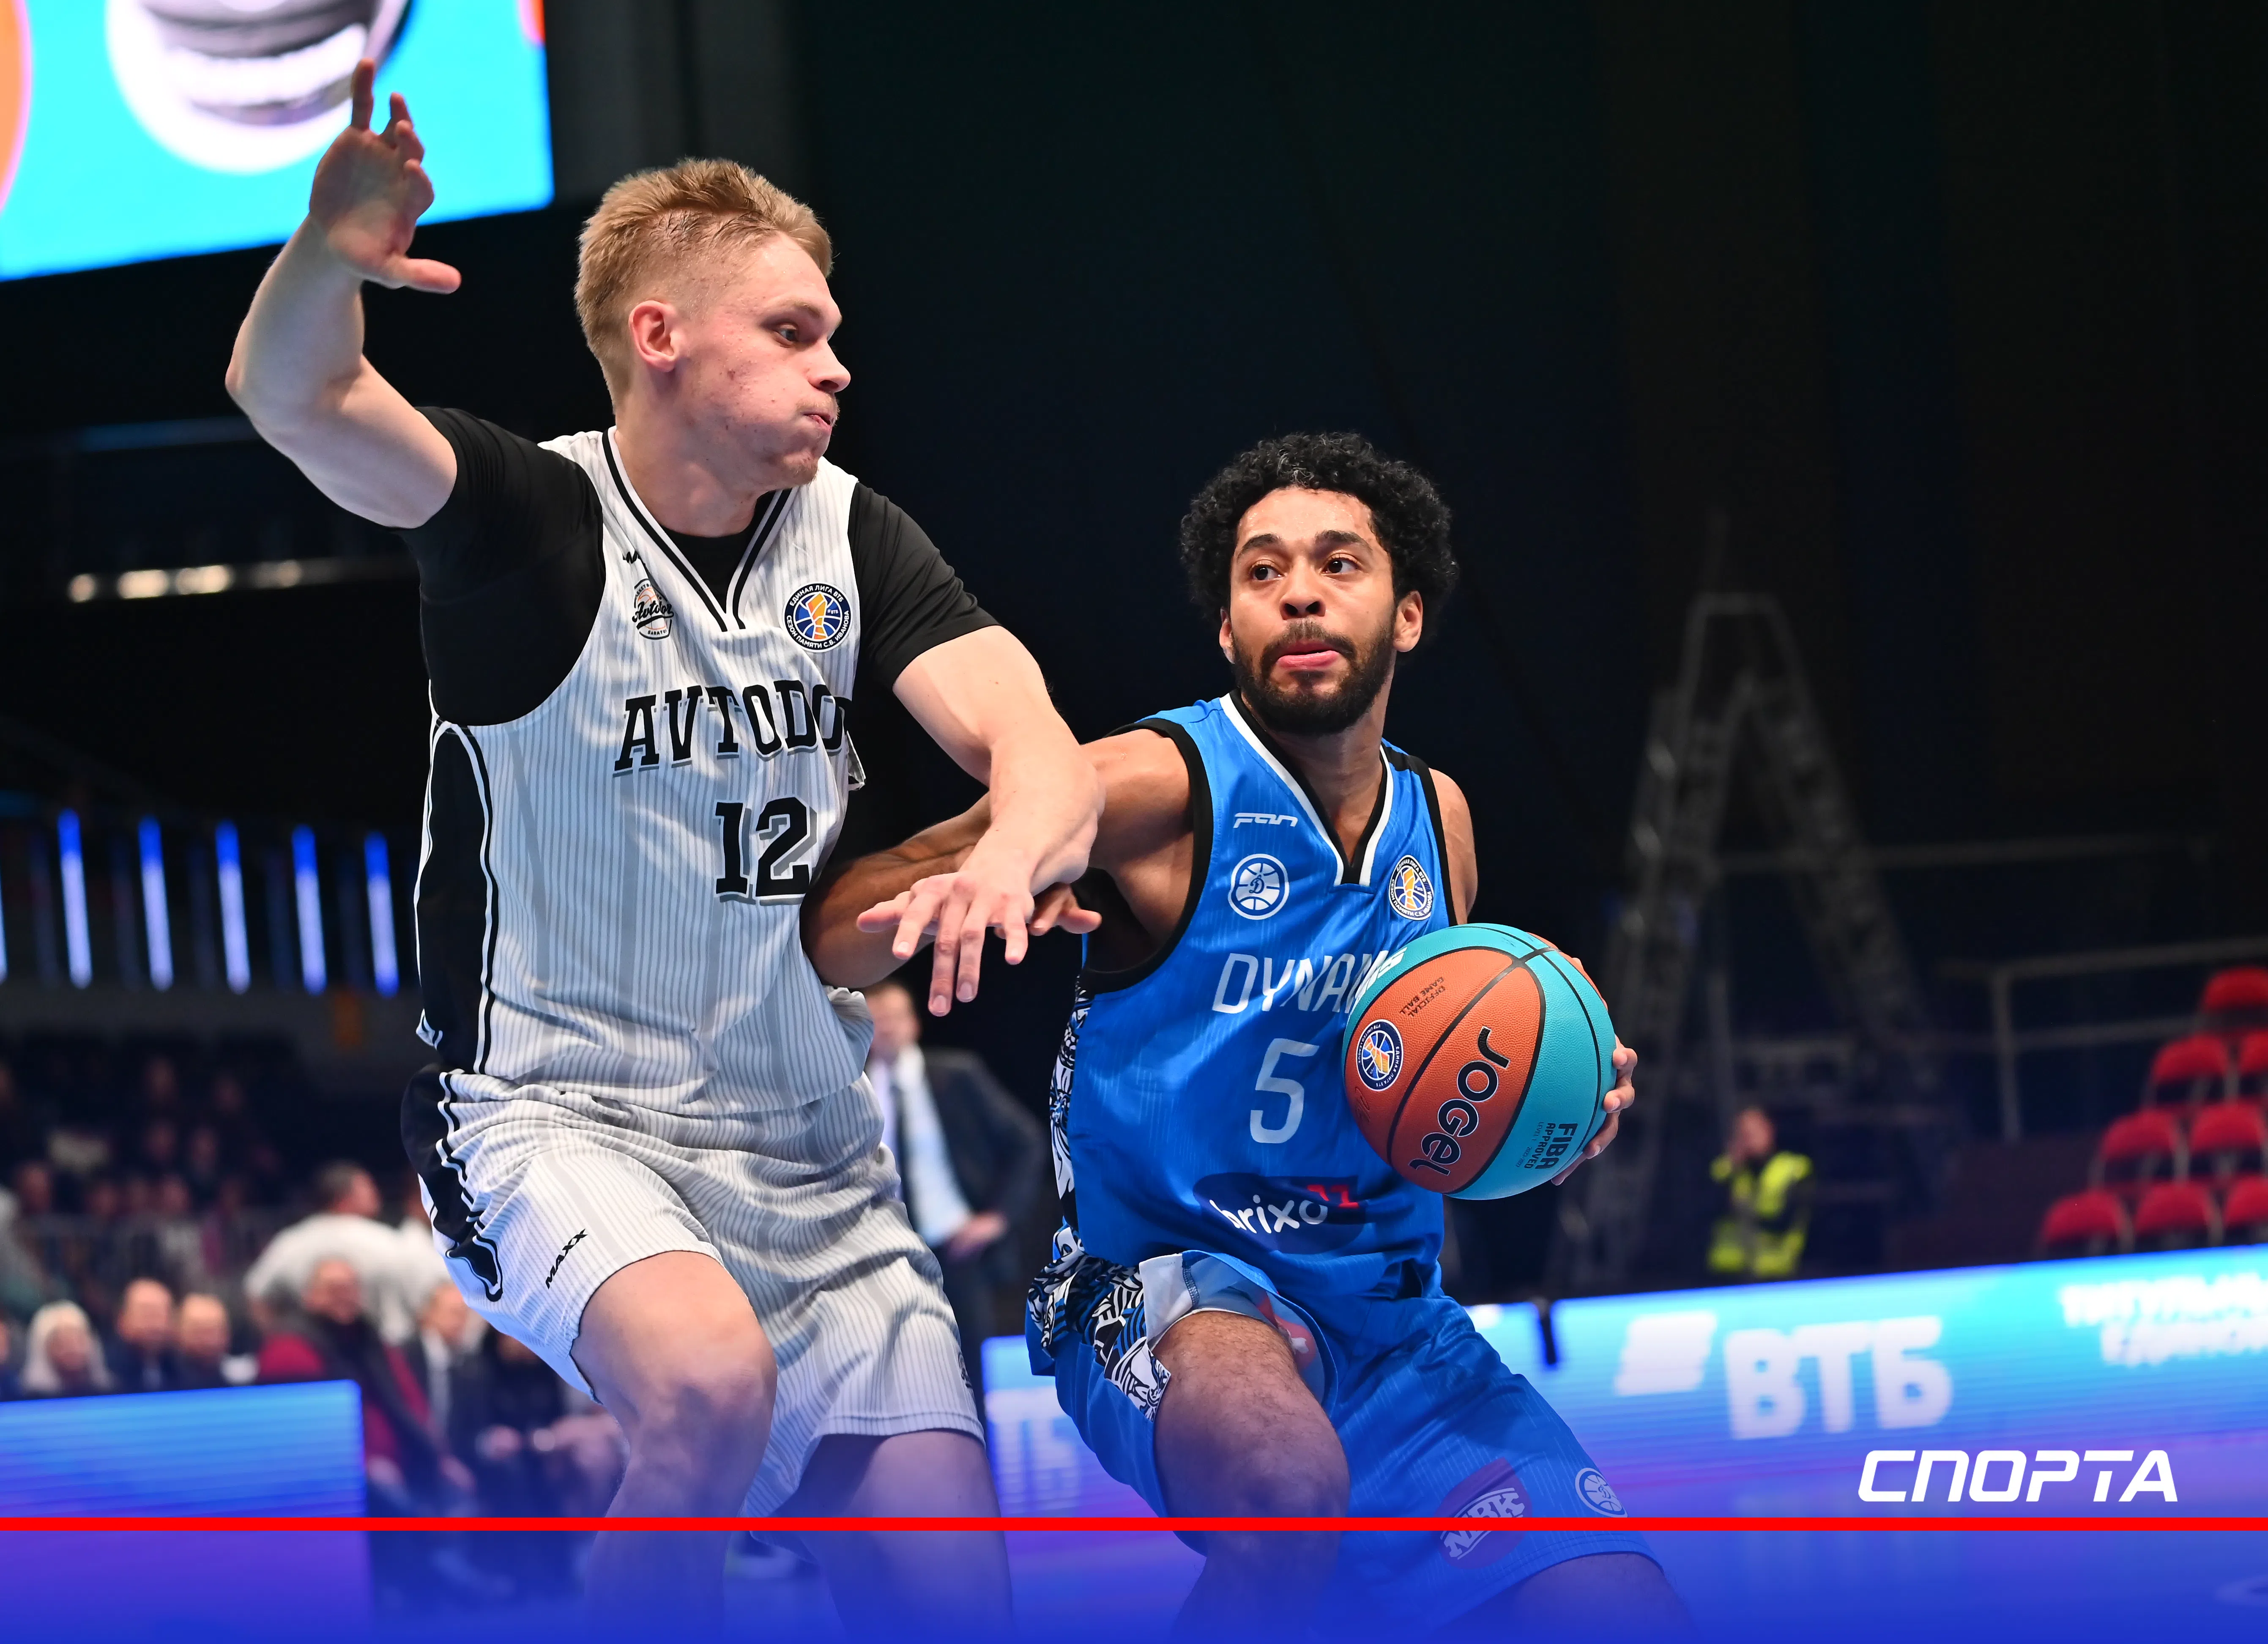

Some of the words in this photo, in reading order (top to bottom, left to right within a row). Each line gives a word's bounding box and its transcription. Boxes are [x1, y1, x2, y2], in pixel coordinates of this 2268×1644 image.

[790, 586, 813, 606] ЕДИНАЯ
[815, 585, 832, 594] ЛИГА
[833, 591, 844, 603] ВТБ
[786, 615, 797, 637] СЕЗОН
[796, 635, 822, 648] ПАМЯТИ
[835, 610, 849, 641] ИВАНОВА
[613, 680, 851, 776] AVTODO
[715, 797, 817, 904] 12
[1212, 950, 1389, 1014] DYNAM
[1399, 995, 1420, 1014] BALL
[1408, 985, 1445, 1017] OFFICIAL
[1362, 1027, 1373, 1042] UNITED
[1250, 1038, 1319, 1143] 5
[1384, 1073, 1394, 1085] ЛИГА
[1524, 1123, 1556, 1168] APPROVED
[1534, 1122, 1544, 1137] LEVEL
[1535, 1123, 1578, 1169] FIBA
[545, 1228, 588, 1289] MAXX
[1724, 1315, 1953, 1440] ВТБ
